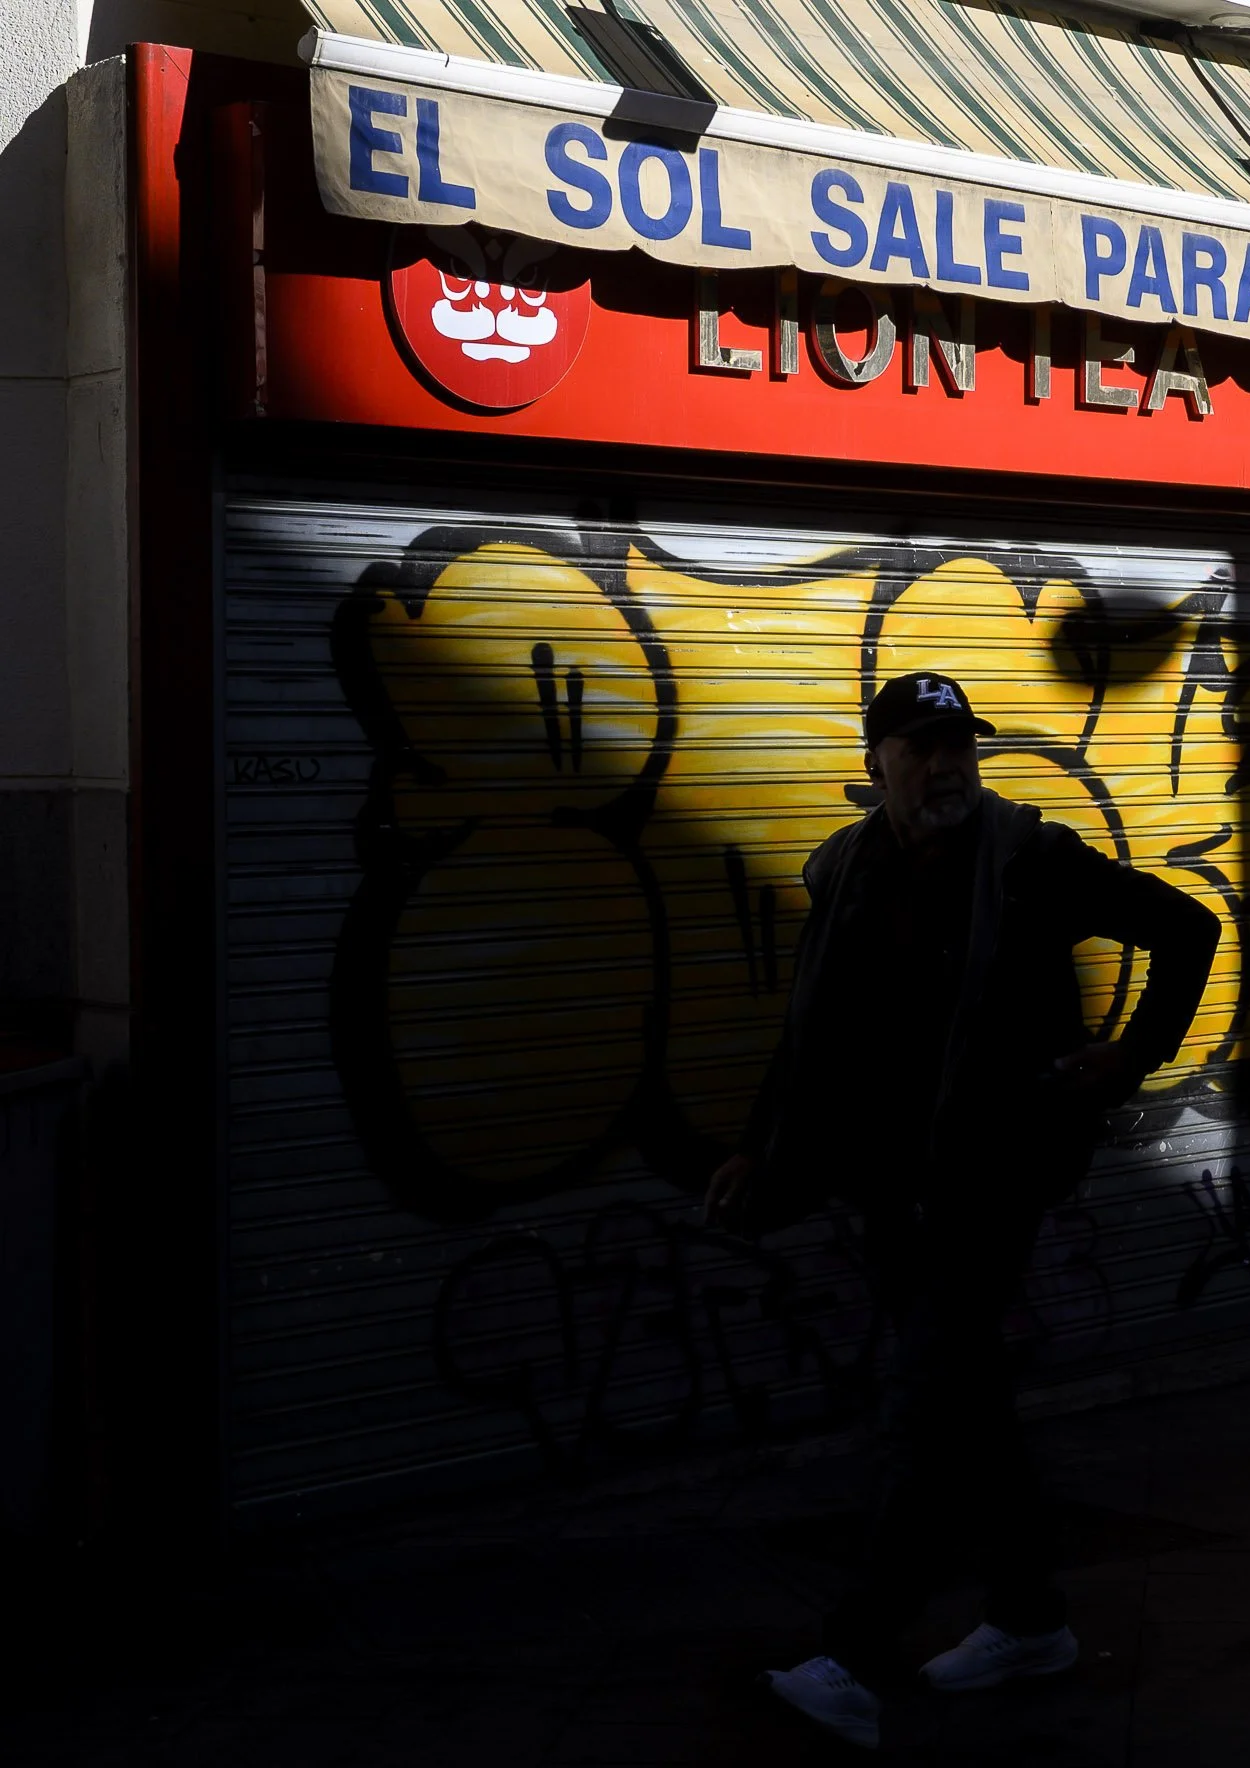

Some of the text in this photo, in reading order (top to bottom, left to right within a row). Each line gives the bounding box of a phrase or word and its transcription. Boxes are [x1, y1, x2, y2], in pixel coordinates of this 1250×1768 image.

[348, 86, 476, 209] EL
[544, 121, 752, 251] SOL
[810, 168, 1030, 292] SALE
[695, 266, 1215, 415] LION TEA
[916, 679, 962, 709] LA
